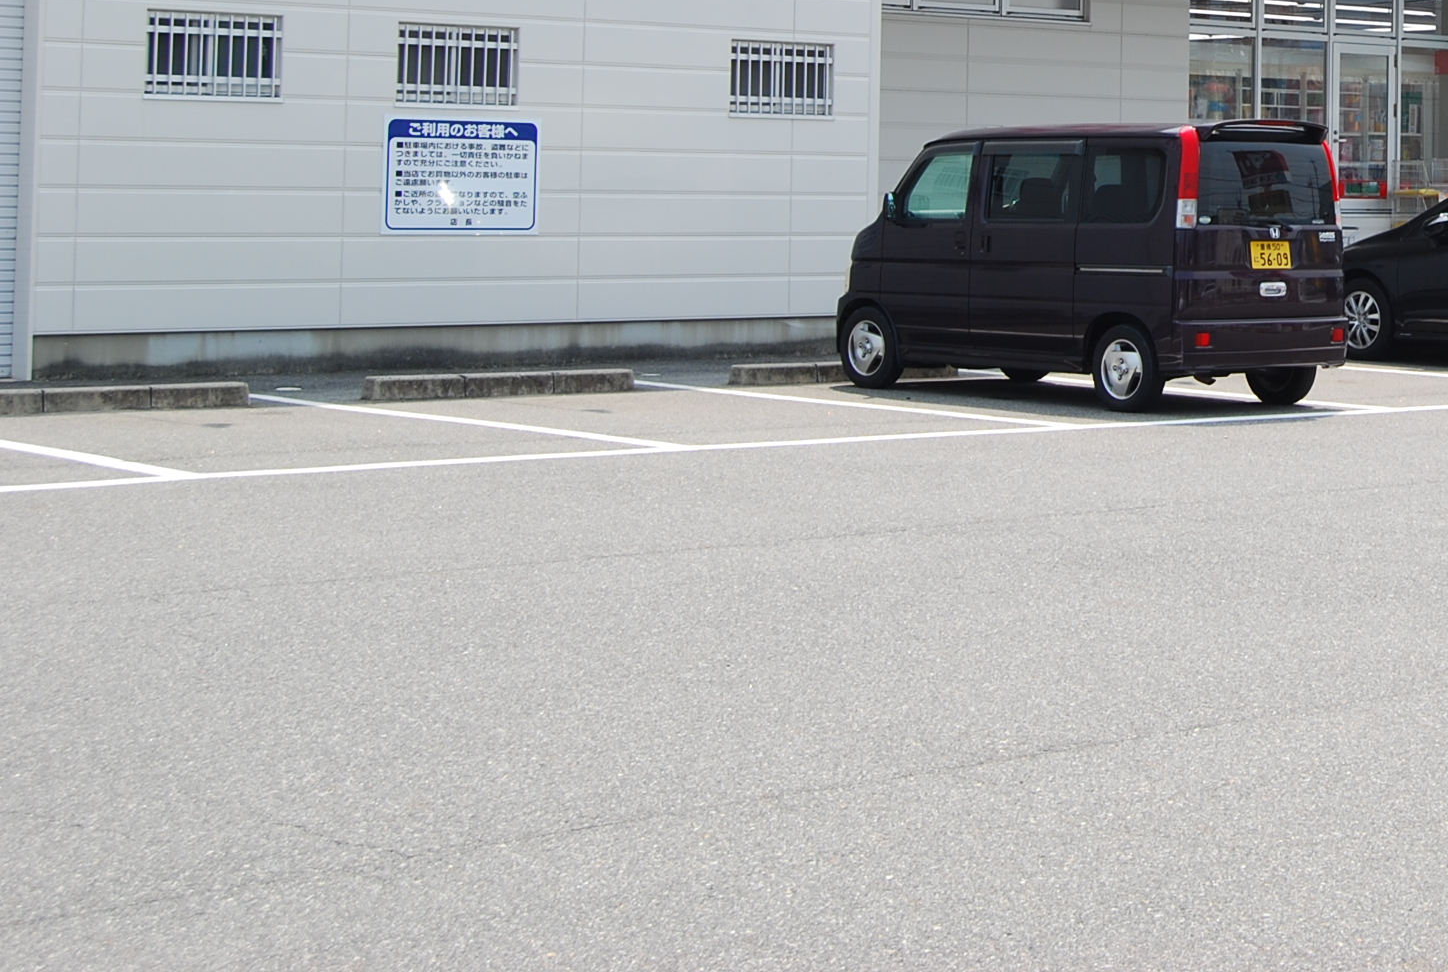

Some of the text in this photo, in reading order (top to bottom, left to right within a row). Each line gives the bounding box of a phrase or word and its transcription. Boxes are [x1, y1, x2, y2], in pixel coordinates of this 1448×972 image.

[408, 122, 519, 138] ご利用のお客様へ
[1260, 252, 1289, 266] 56-09
